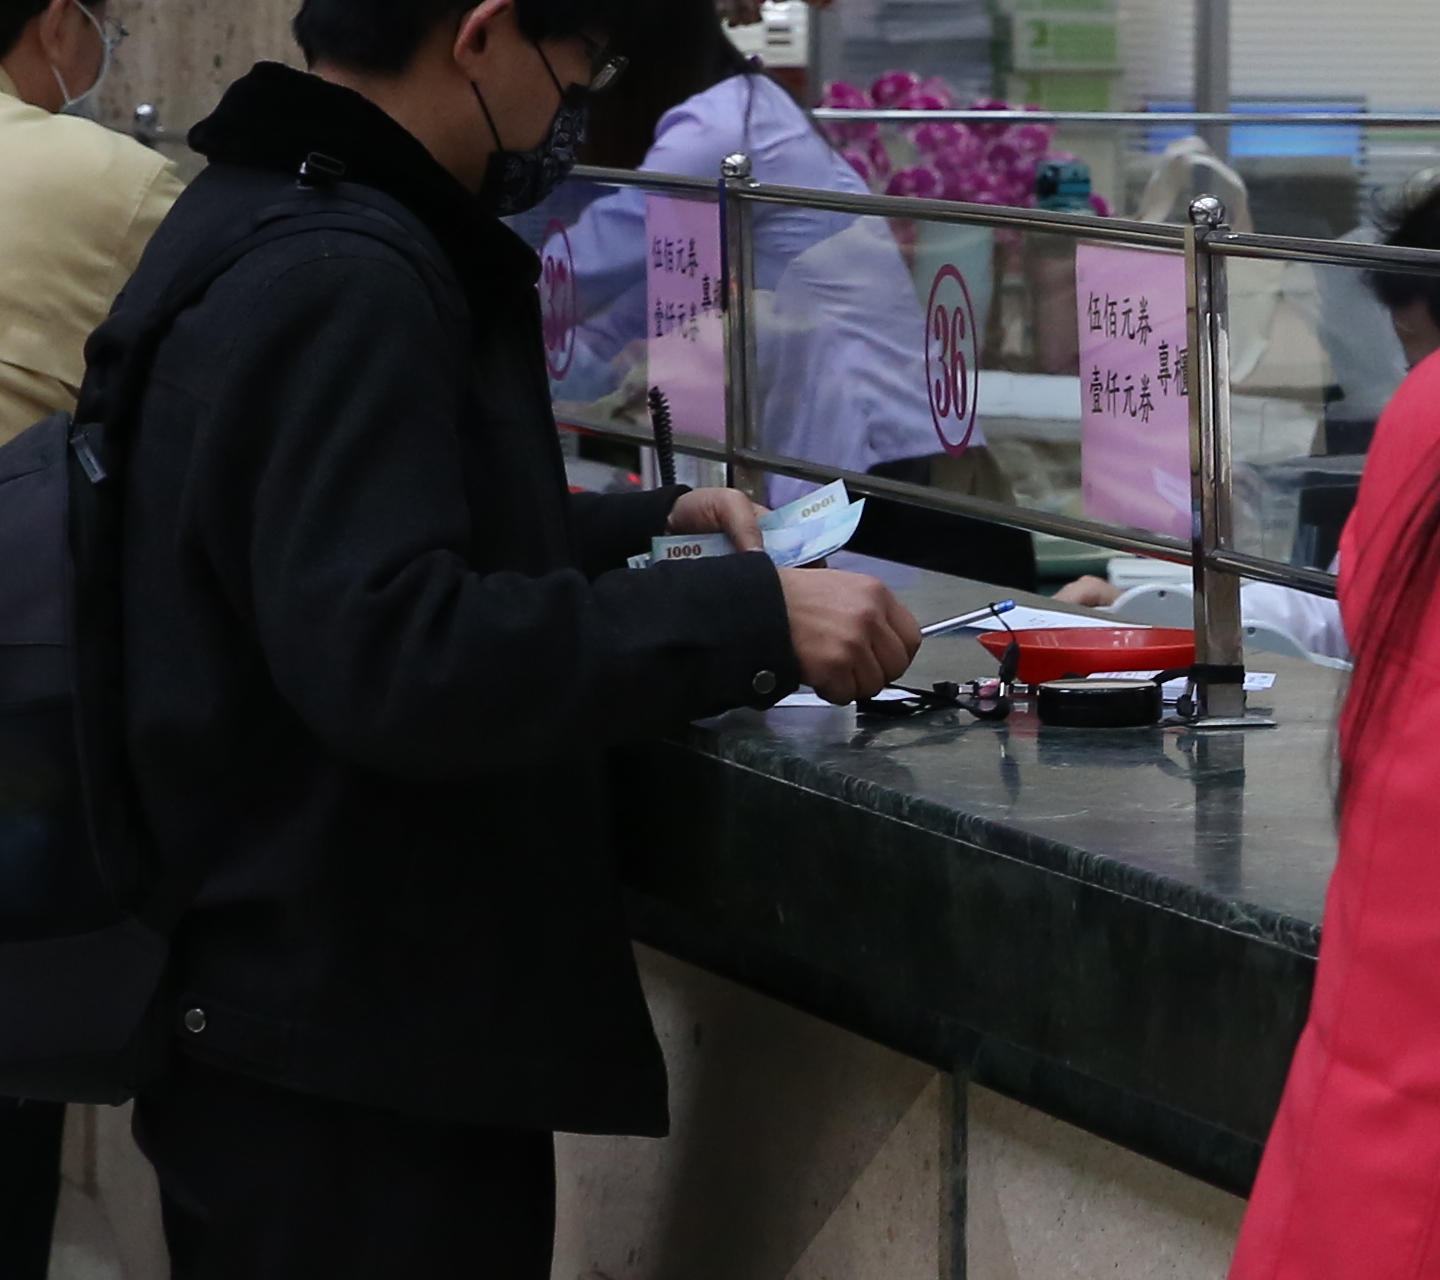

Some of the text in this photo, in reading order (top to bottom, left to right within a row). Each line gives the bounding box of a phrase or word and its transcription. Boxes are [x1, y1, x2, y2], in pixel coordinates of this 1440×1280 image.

[1087, 291, 1153, 346] 伍佰元券
[934, 304, 967, 421] 36
[1089, 364, 1155, 424] 壹仟元券
[801, 494, 836, 518] 1000
[665, 544, 702, 558] 1000
